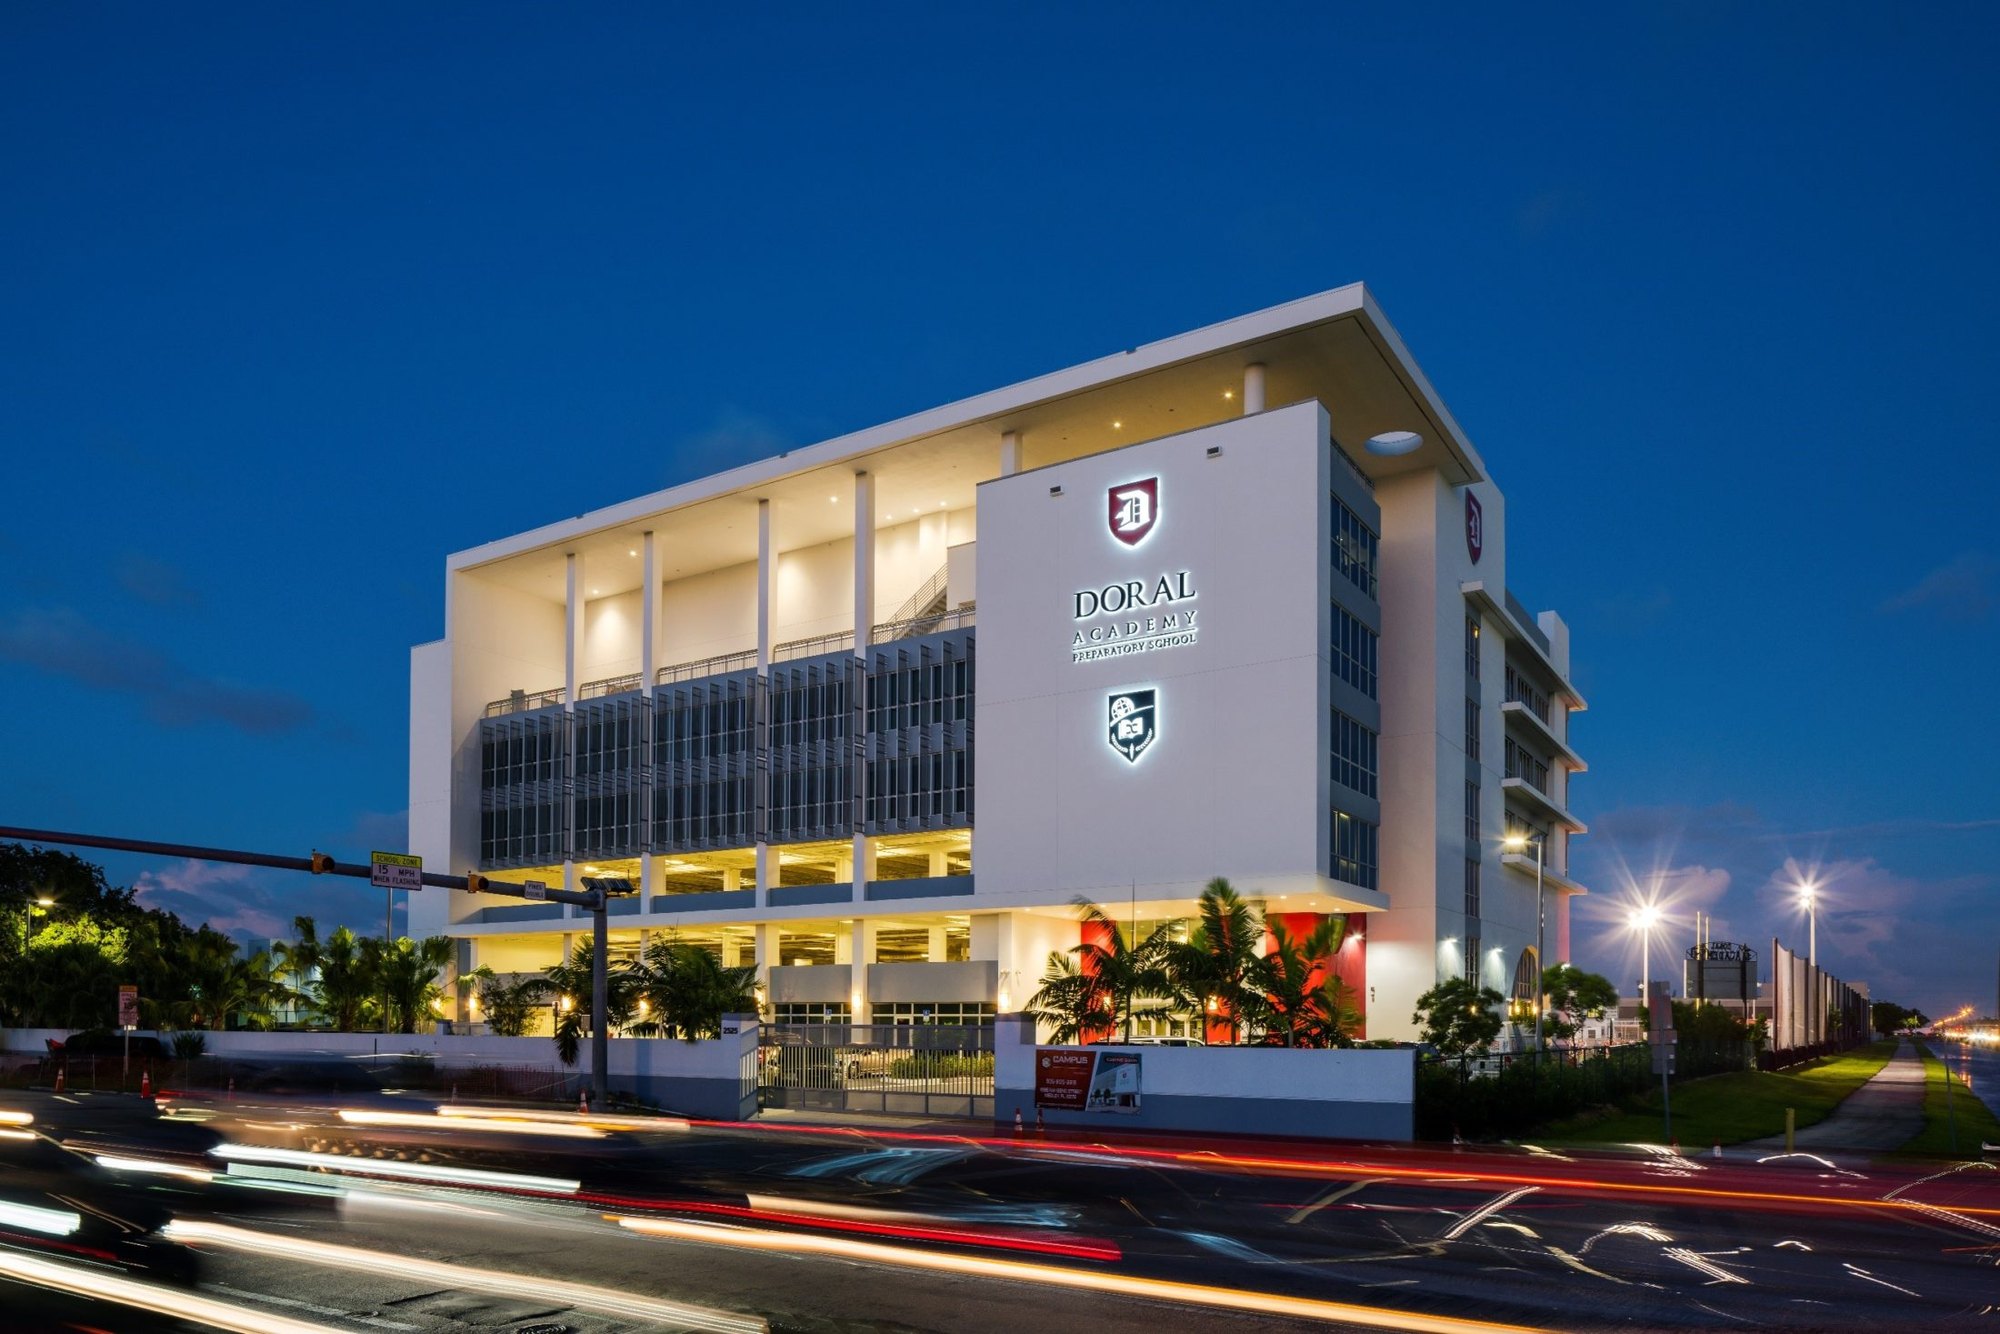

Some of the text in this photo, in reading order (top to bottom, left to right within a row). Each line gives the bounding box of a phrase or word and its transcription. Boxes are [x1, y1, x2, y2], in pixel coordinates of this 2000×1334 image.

[1073, 571, 1196, 619] DORAL
[1072, 610, 1196, 645] ACADEMY
[1072, 634, 1197, 662] PREPARATORY SCHOOL
[375, 854, 419, 867] SCHOOL ZONE
[378, 864, 416, 878] 15 MPH
[373, 875, 420, 888] WHEN FLASHING
[1053, 1055, 1088, 1064] CAMPUS
